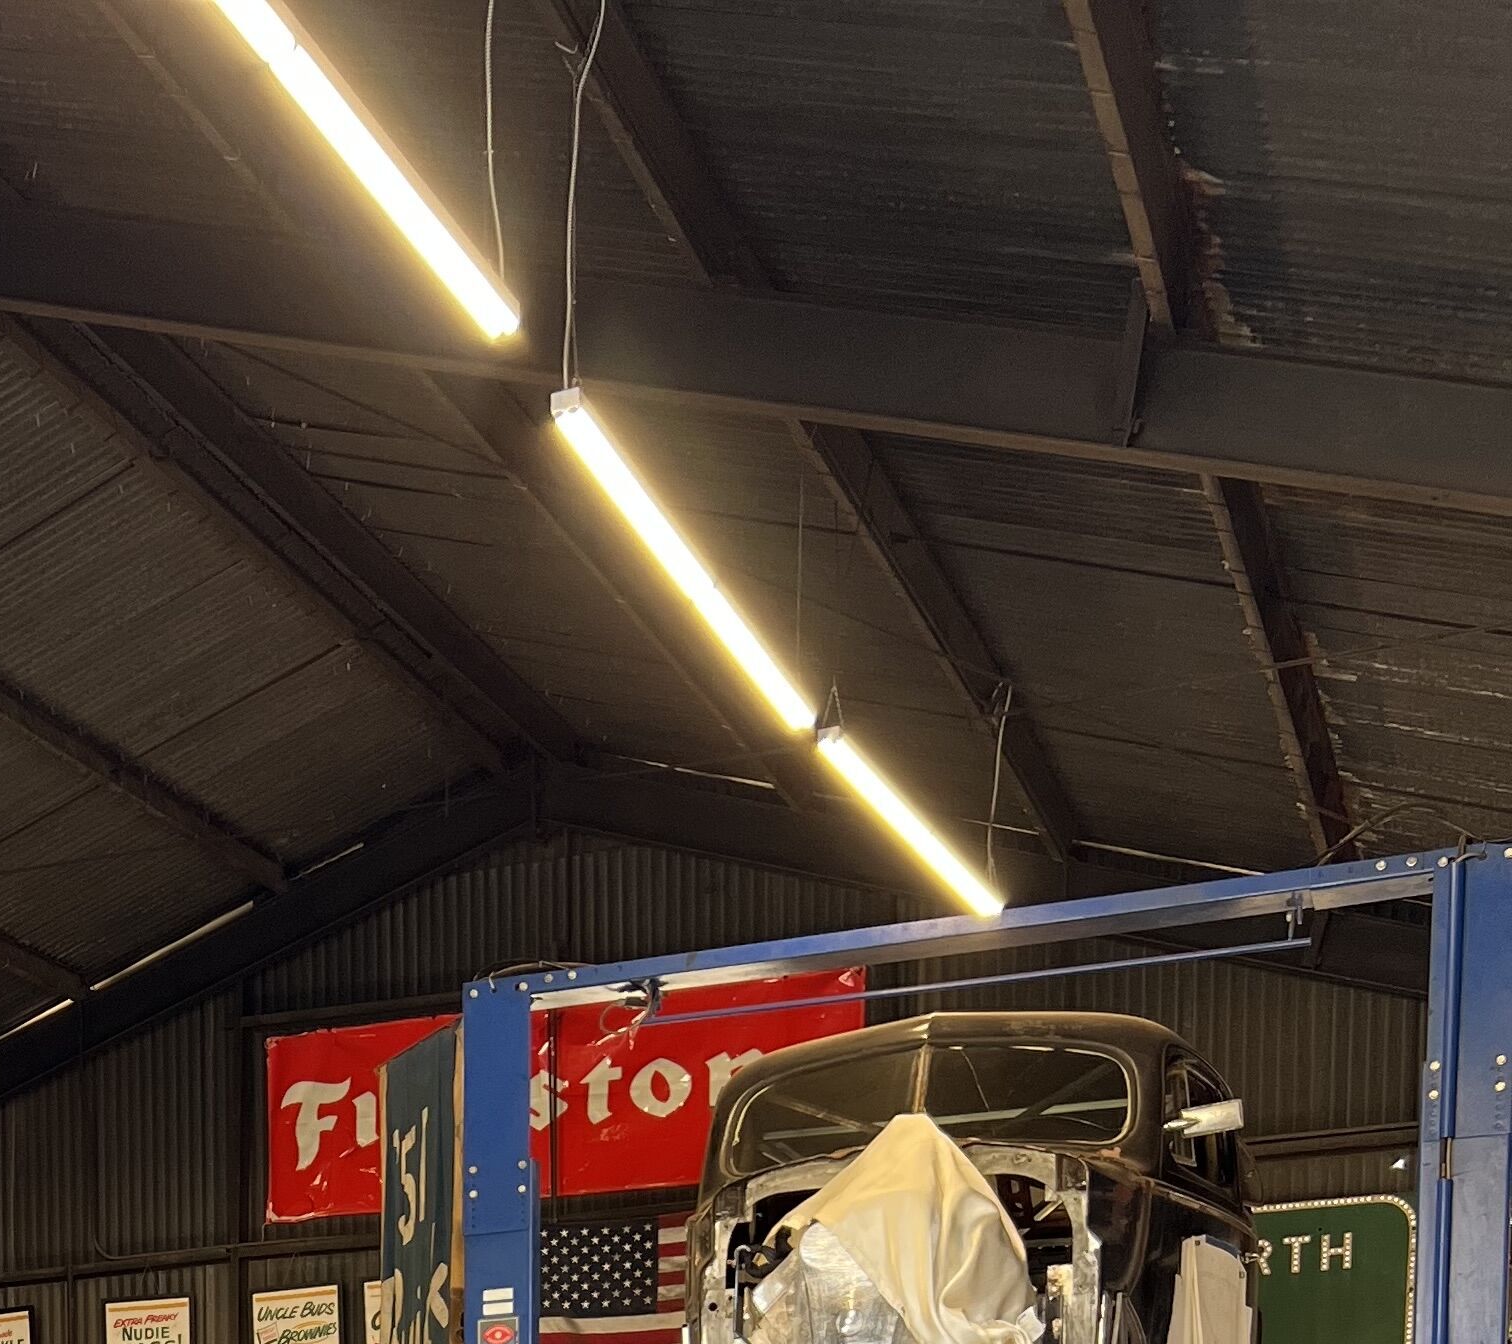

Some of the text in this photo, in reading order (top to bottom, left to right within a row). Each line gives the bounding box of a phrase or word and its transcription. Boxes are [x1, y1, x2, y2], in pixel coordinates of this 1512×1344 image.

[281, 1049, 765, 1172] Fiston
[1258, 1231, 1353, 1276] RTH
[113, 1312, 179, 1329] EXTRA FREAKY
[257, 1301, 335, 1323] UNCLE BUDS
[122, 1326, 170, 1341] NUDIE
